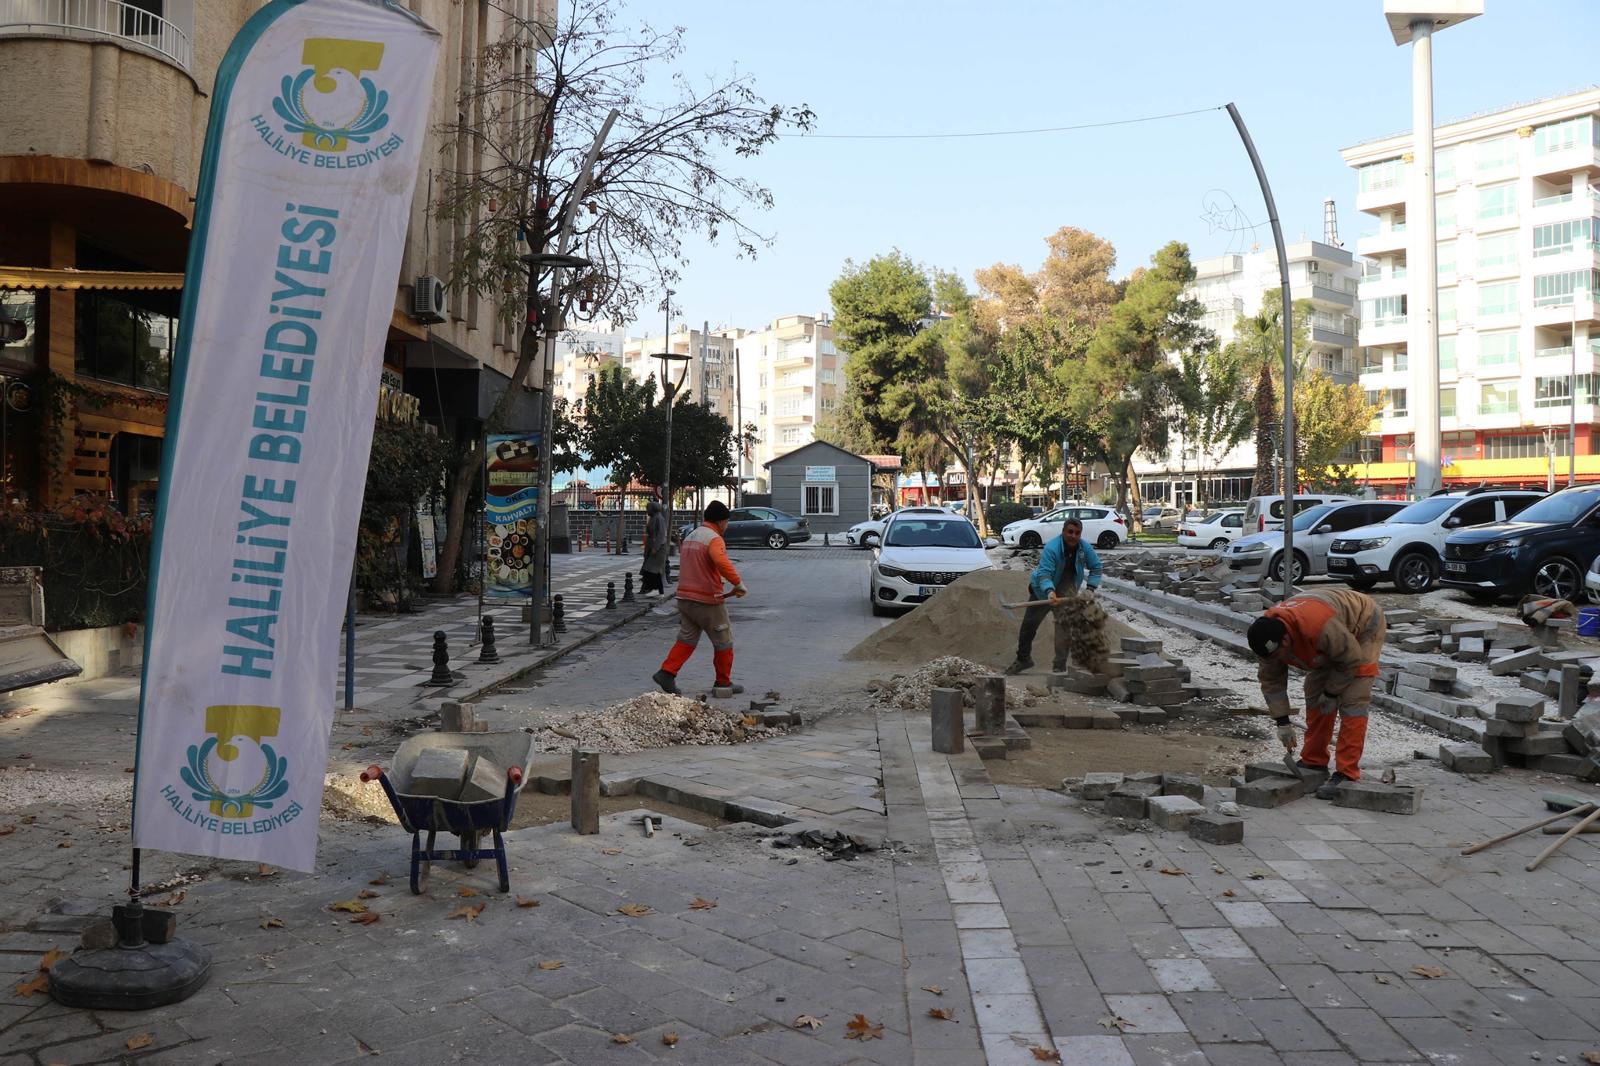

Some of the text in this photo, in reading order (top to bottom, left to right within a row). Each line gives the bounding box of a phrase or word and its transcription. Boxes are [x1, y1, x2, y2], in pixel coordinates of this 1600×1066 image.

[314, 132, 404, 169] BELEDİYESİ
[505, 490, 529, 504] OKEY
[221, 799, 303, 835] BELEDİYESİ
